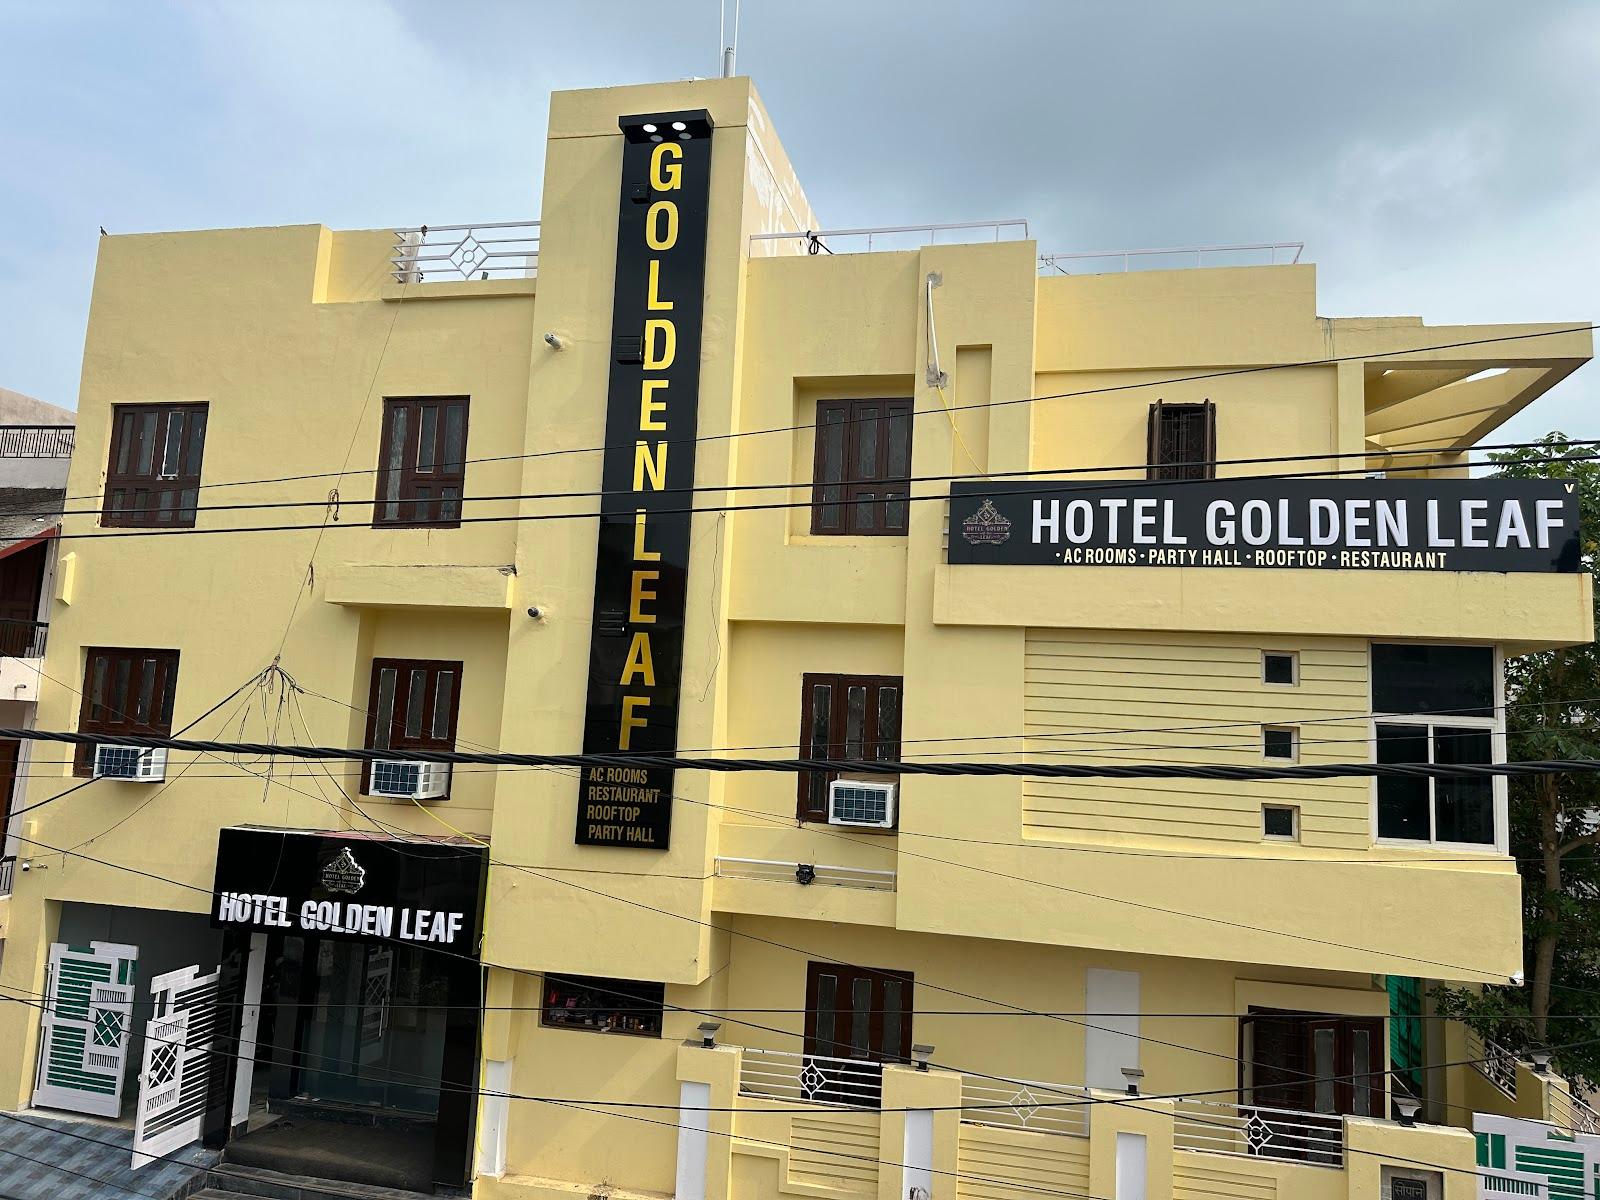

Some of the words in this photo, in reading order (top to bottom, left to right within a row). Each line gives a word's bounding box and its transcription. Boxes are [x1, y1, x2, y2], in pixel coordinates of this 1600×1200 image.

[633, 142, 682, 491] GOLDEN
[1031, 498, 1188, 544] HOTEL
[1206, 498, 1409, 547] GOLDEN
[1427, 498, 1564, 549] LEAF
[1063, 548, 1082, 564] AC
[1085, 548, 1137, 564] ROOMS
[1148, 549, 1198, 565] PARTY
[1202, 549, 1242, 566] HALL
[1255, 549, 1327, 567] ROOFTOP
[1340, 550, 1448, 569] RESTAURANT
[620, 508, 661, 750] LEAF
[589, 767, 604, 782] AC
[607, 768, 648, 784] ROOMS
[588, 786, 660, 803] RESTAURANT
[586, 804, 641, 822] ROOFTOP
[588, 824, 624, 840] PARTY
[626, 826, 655, 842] HALL
[218, 891, 293, 928] HOTEL
[300, 900, 394, 938] GOLDEN
[399, 907, 464, 944] LEAF
